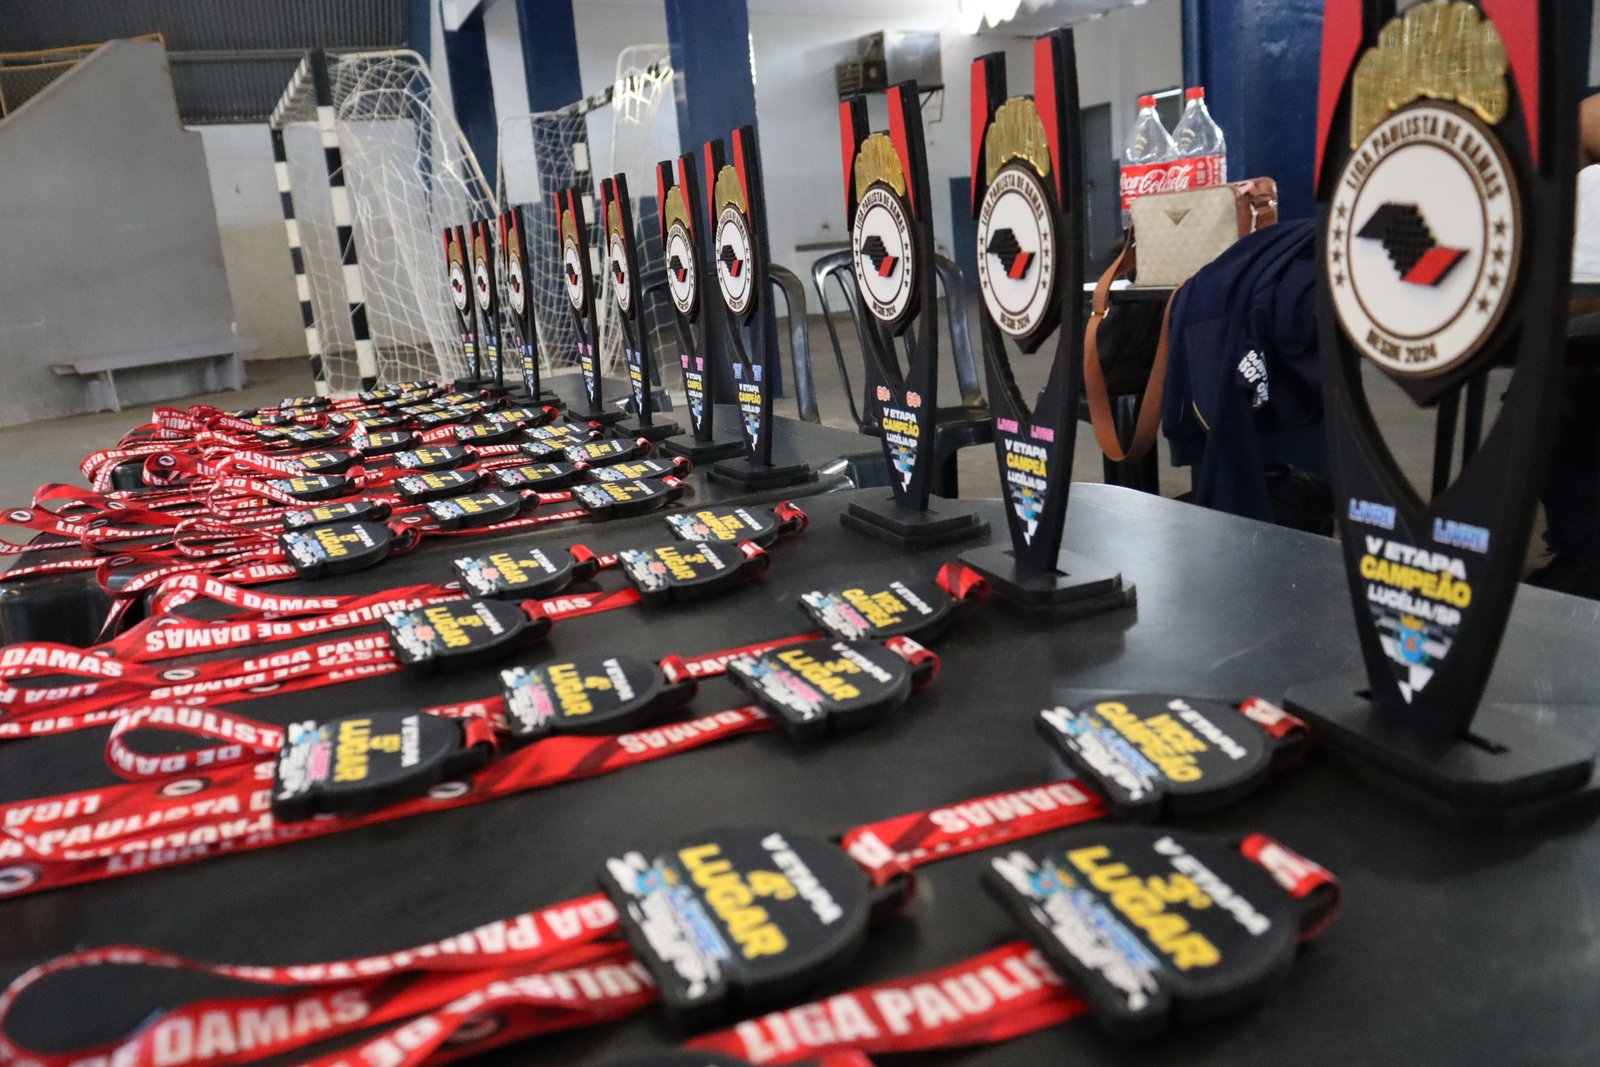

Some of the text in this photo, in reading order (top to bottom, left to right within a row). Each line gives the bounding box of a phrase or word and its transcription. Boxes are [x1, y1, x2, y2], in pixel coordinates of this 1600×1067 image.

[1373, 114, 1439, 156] PAULISTA
[890, 409, 917, 423] ETAPA
[1013, 441, 1048, 461] ETAPA
[655, 546, 697, 581] LUGAR
[1365, 535, 1467, 580] V ETAPA
[204, 579, 238, 602] DE
[243, 593, 339, 612] DAMAS
[1360, 555, 1472, 608] CAMPEÃO
[145, 623, 251, 653] DAMAS
[257, 623, 293, 638] DE
[424, 606, 472, 648] LUGAR
[1, 647, 123, 678] DAMAS
[243, 649, 312, 672] LIGA
[777, 649, 861, 701] LUGAR
[548, 663, 593, 717] LUGAR
[617, 710, 744, 754] DAMAS
[928, 783, 1090, 834] DAMAS
[678, 843, 788, 960] LUGAR
[1067, 845, 1221, 970] LUGAR
[152, 988, 372, 1067] DAMAS
[735, 995, 877, 1066] LIGA
